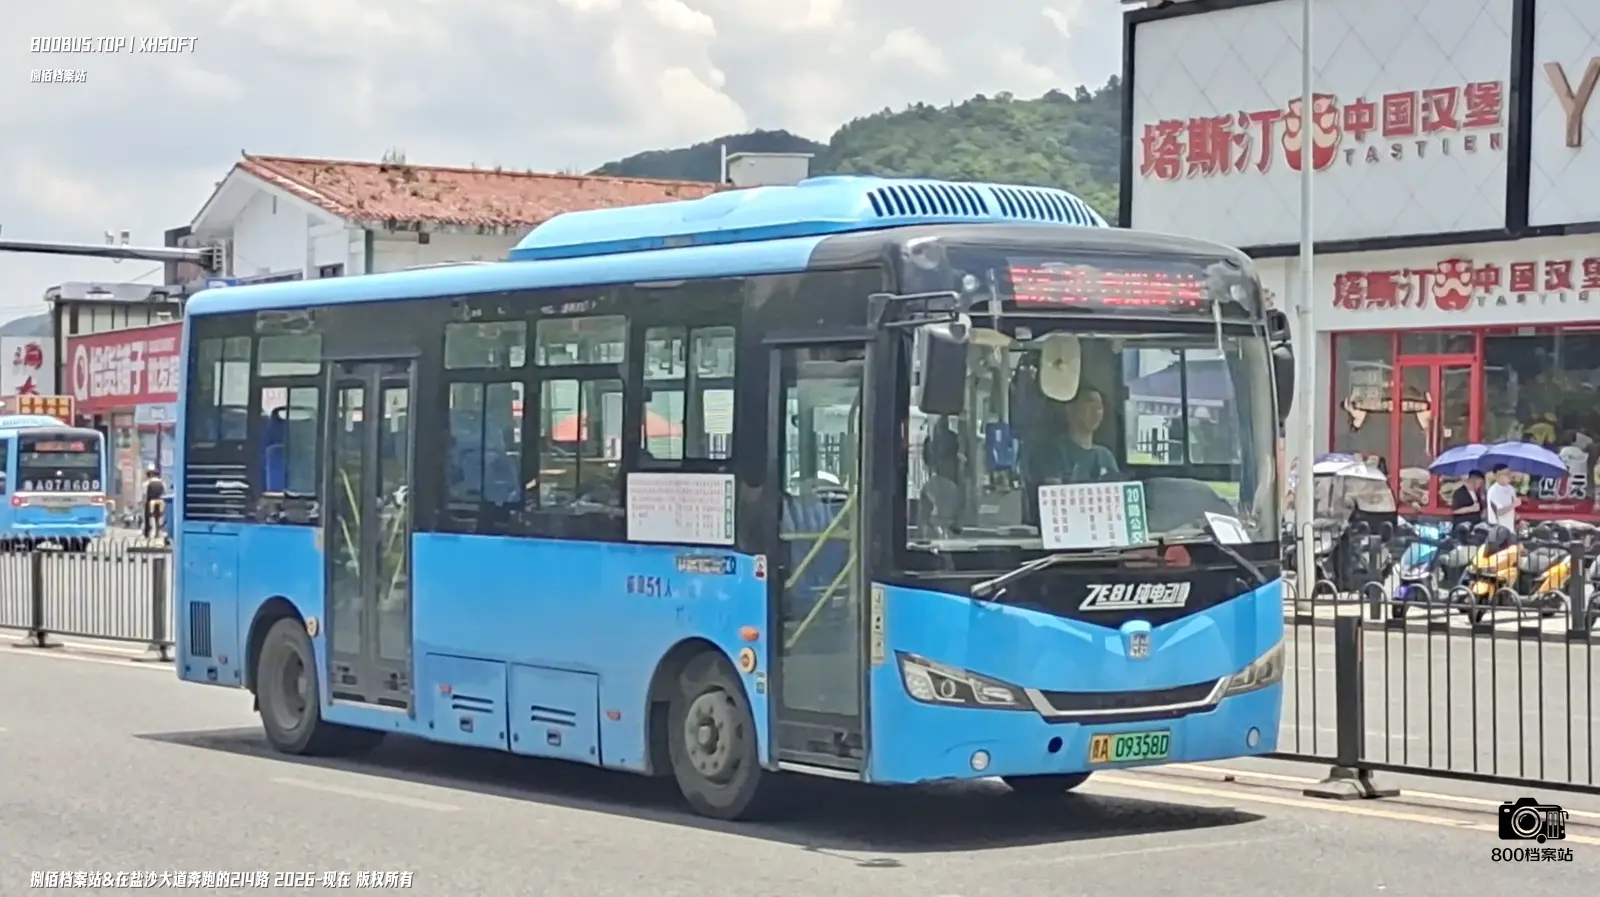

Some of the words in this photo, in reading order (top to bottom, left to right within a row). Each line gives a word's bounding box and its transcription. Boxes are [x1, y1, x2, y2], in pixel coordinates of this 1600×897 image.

[1140, 109, 1283, 181] 塔斯汀
[1343, 80, 1503, 143] 中国汉堡
[1543, 56, 1600, 148] Y
[1344, 132, 1503, 166] TASTIEN
[1333, 268, 1435, 310] 塔斯汀
